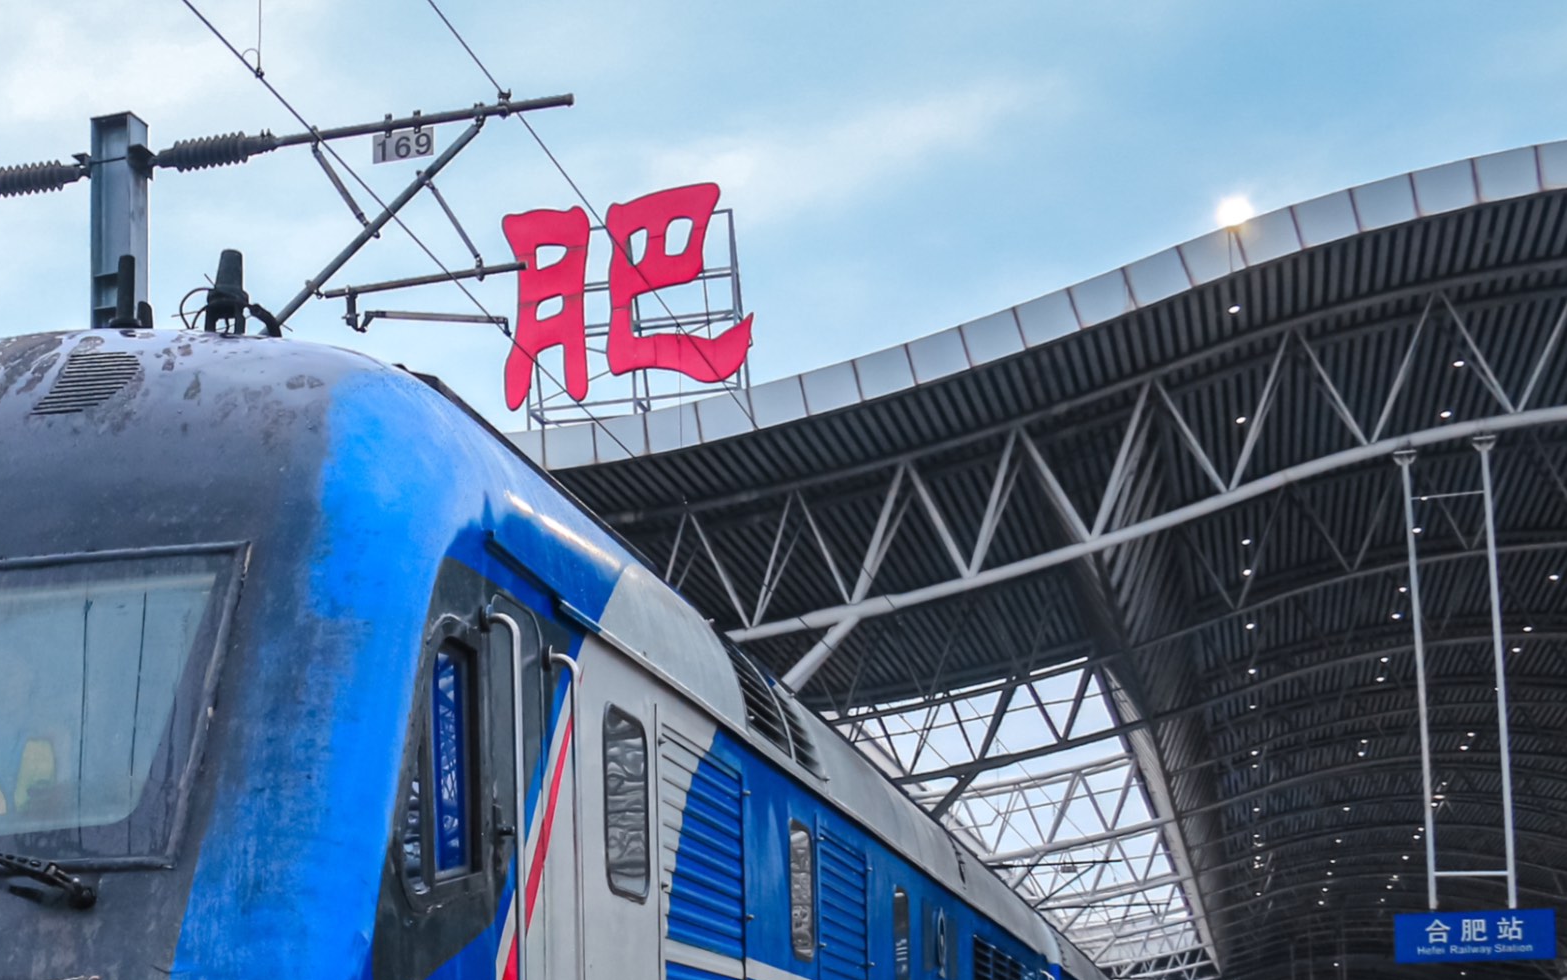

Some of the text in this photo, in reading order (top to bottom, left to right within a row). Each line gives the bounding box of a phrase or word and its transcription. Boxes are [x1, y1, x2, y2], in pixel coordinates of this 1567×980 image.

[377, 133, 432, 162] 169
[501, 182, 754, 411] 肥
[1425, 916, 1524, 943] 合肥站
[1417, 943, 1533, 955] Hefei Railway Station
